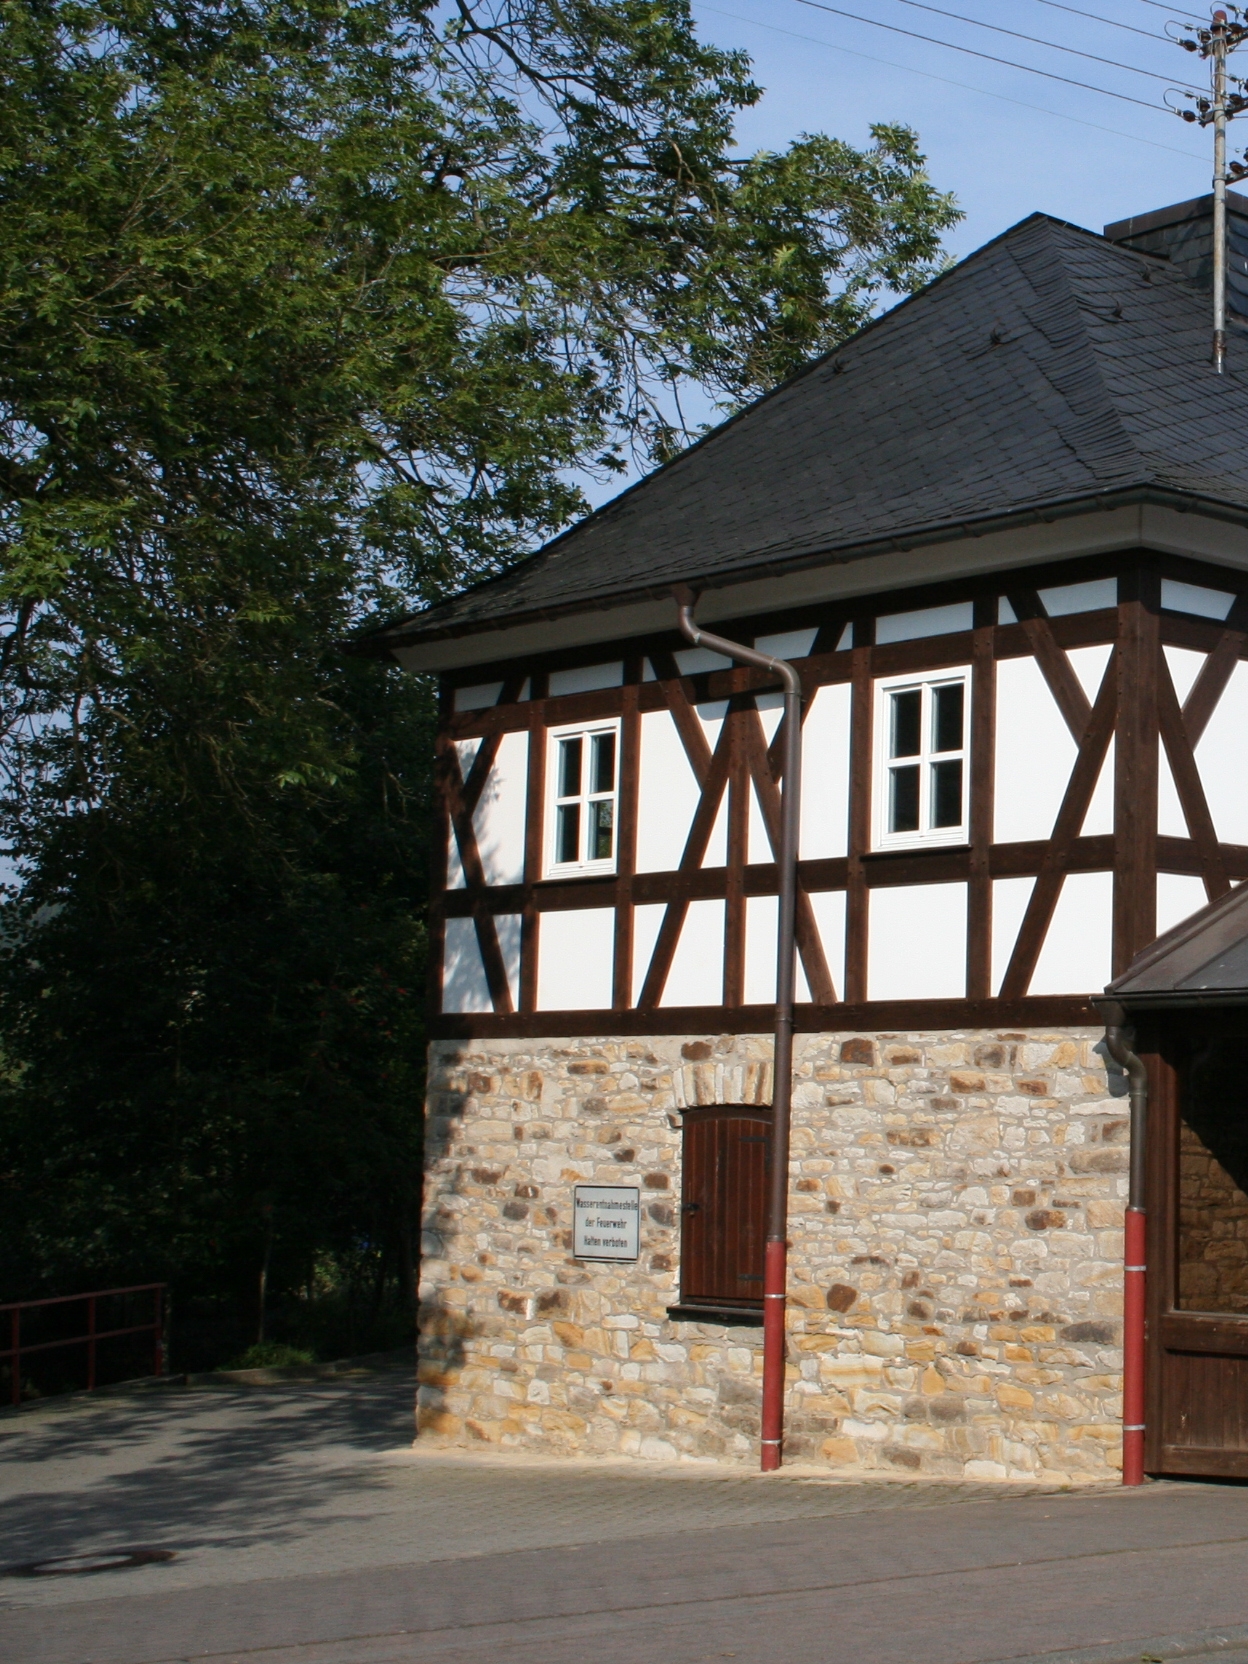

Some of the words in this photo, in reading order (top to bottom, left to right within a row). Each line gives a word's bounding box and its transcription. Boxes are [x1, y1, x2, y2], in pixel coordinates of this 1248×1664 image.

[576, 1198, 638, 1210] Wasserentnahmestelle
[585, 1217, 595, 1227] der
[597, 1217, 627, 1228] Feuerwehr
[584, 1235, 601, 1246] Halten
[602, 1237, 627, 1248] verboten
